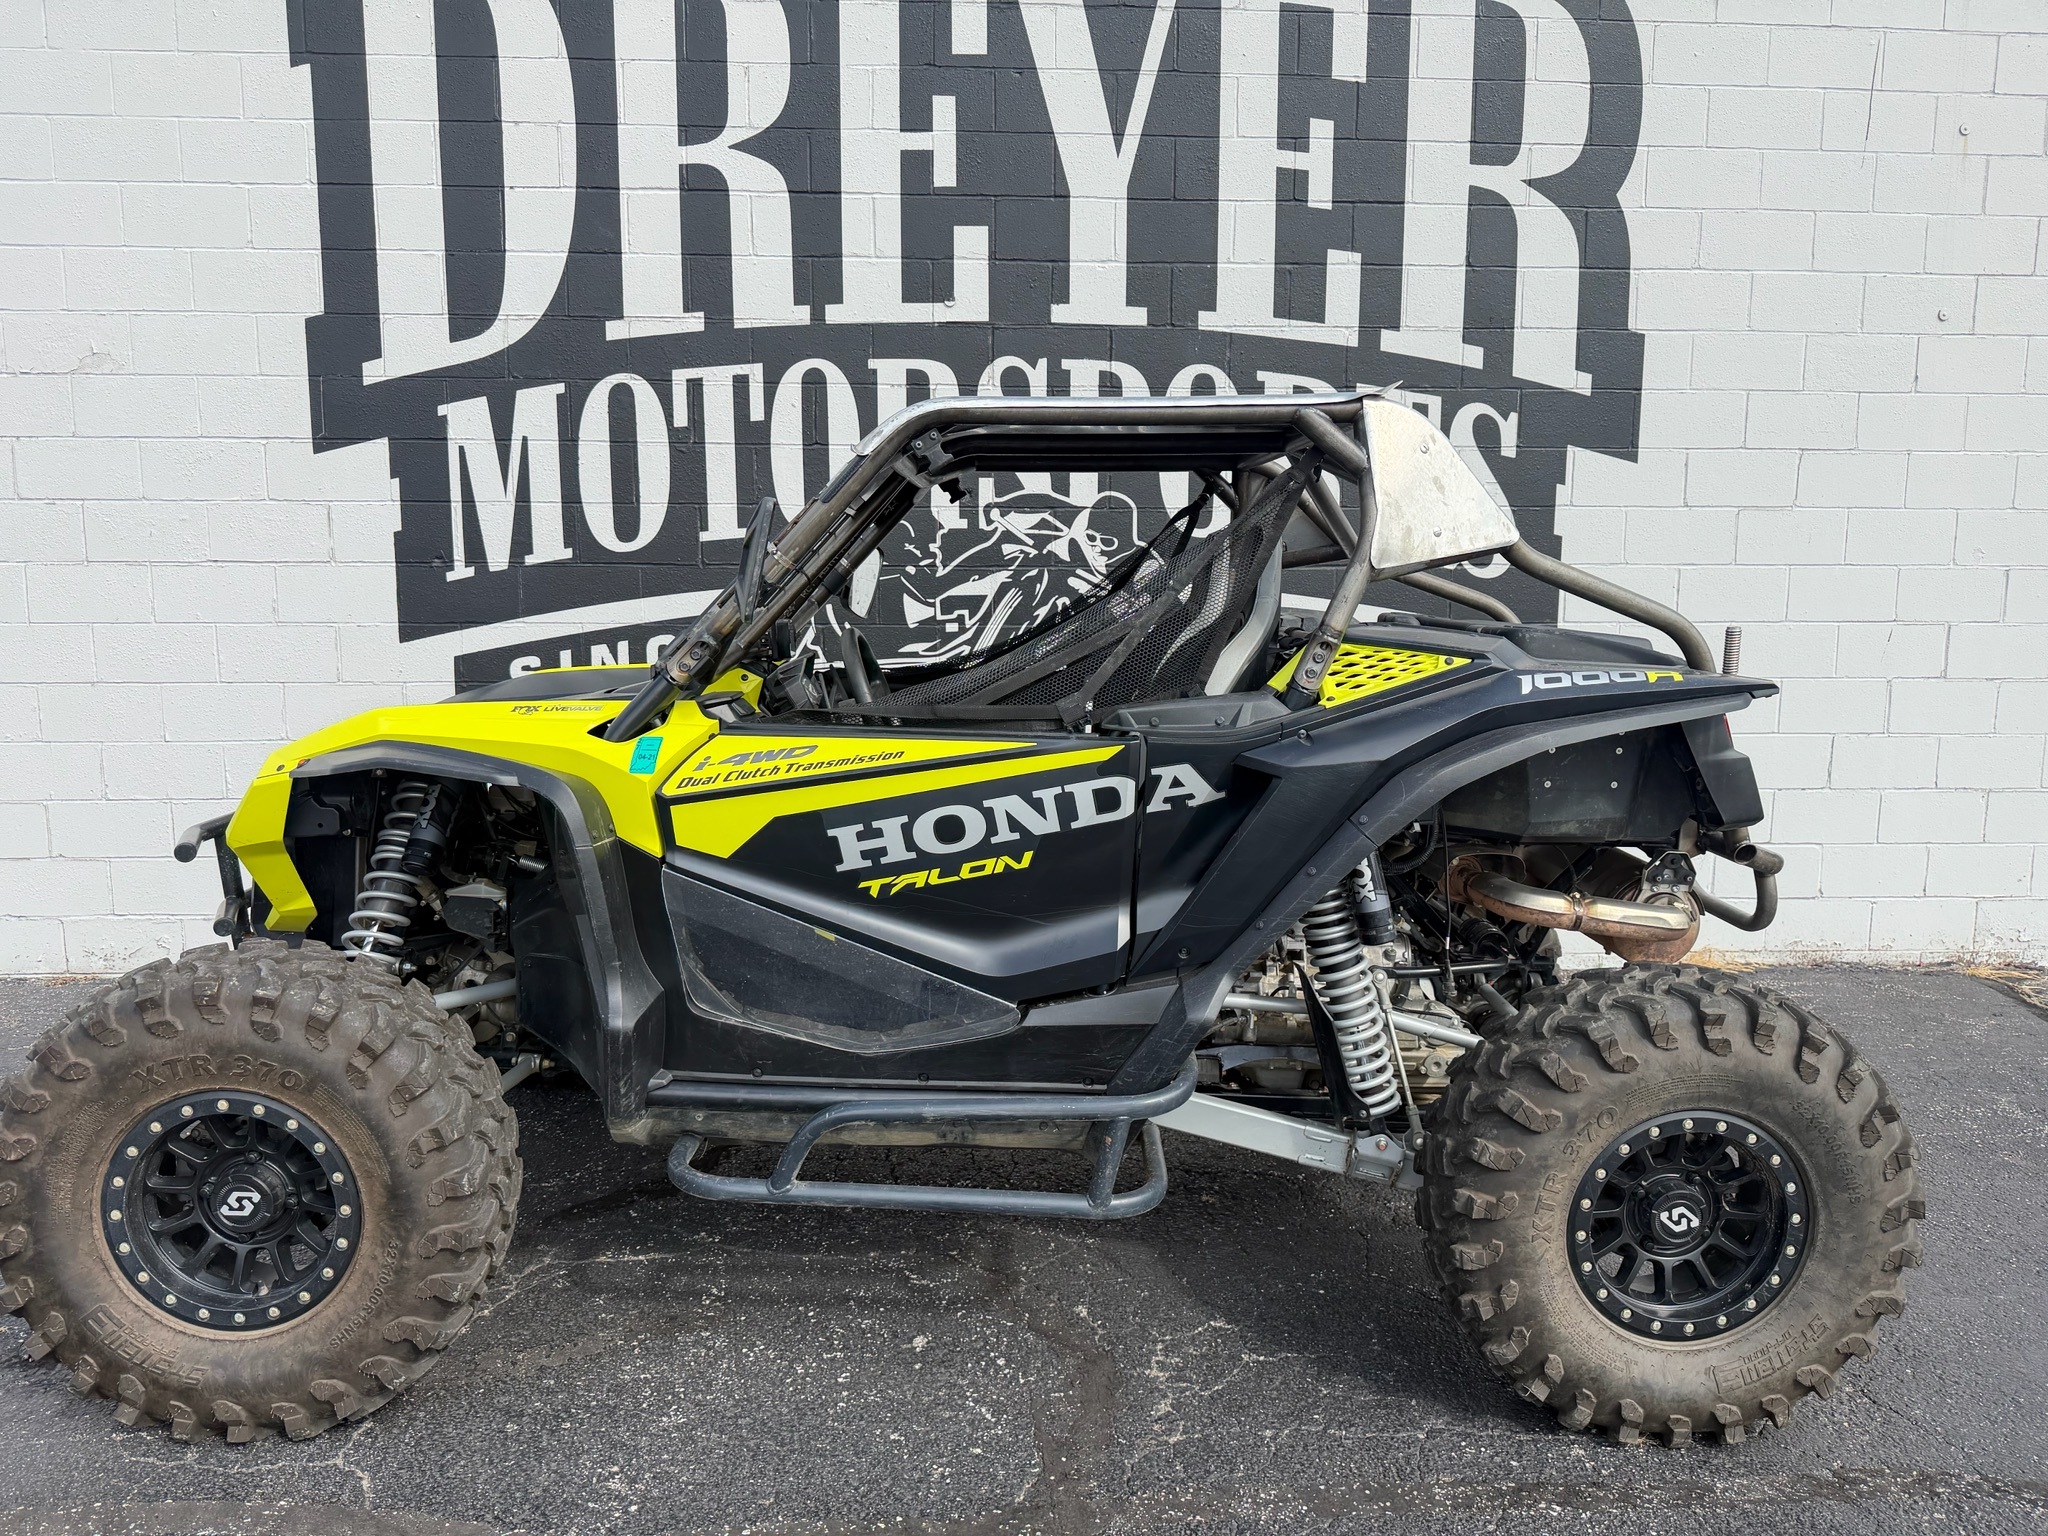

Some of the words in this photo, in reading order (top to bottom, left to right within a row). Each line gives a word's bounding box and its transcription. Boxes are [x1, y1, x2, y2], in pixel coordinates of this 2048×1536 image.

[362, 0, 1593, 396] DREYER
[437, 354, 1519, 580] MOTOROS
[1517, 670, 1684, 695] 1000R
[676, 772, 721, 790] Dual
[723, 766, 780, 782] Clutch
[785, 751, 905, 774] Transmission
[827, 763, 1226, 873] HONDA
[858, 850, 1034, 898] TALON
[132, 1054, 216, 1093] XTR
[231, 1054, 304, 1092] 370
[1562, 1106, 1619, 1158] 370
[1530, 1172, 1566, 1244] XTR
